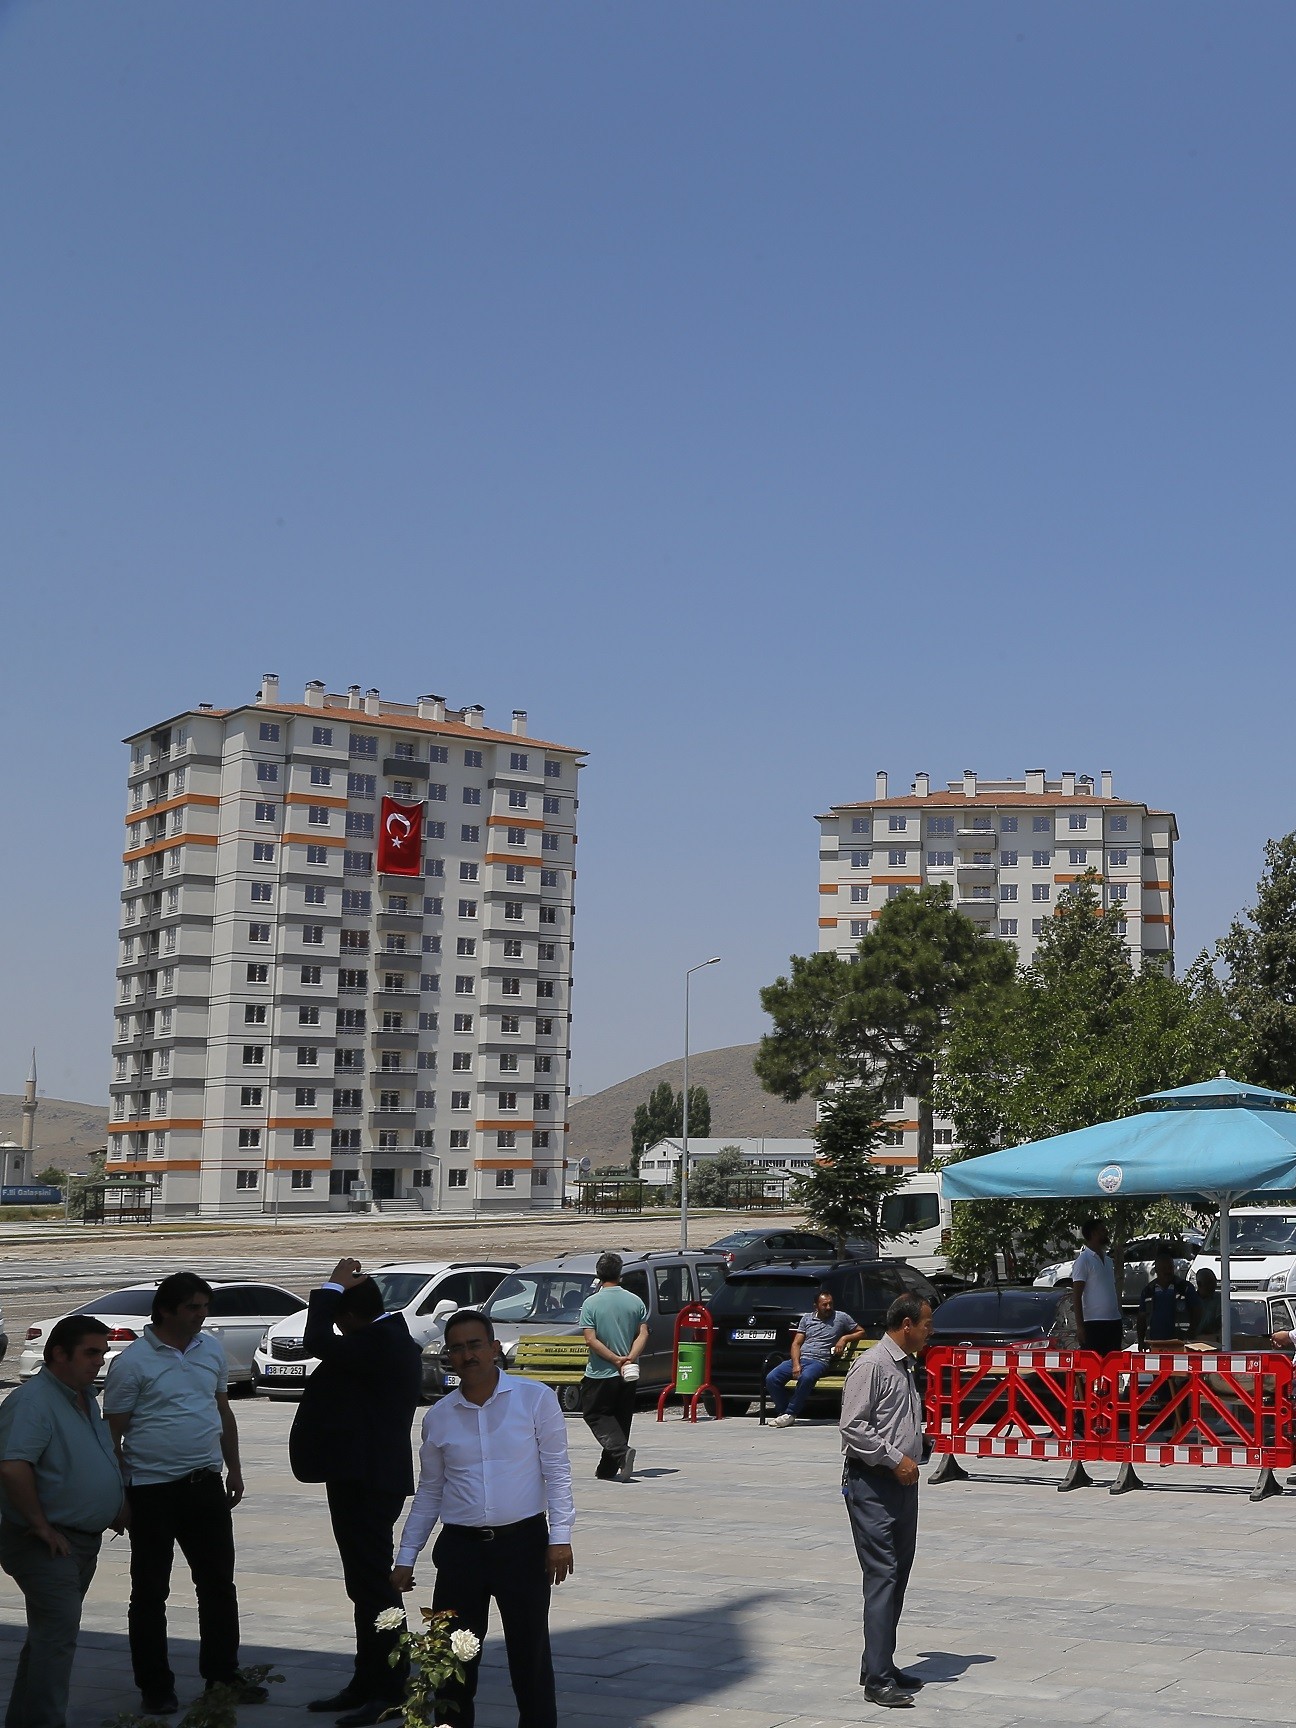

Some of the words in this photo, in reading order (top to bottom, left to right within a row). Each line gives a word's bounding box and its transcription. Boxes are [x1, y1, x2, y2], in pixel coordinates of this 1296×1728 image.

[763, 1331, 776, 1339] 791
[268, 1366, 277, 1375] 38
[279, 1366, 288, 1375] FZ
[290, 1366, 302, 1375] 252
